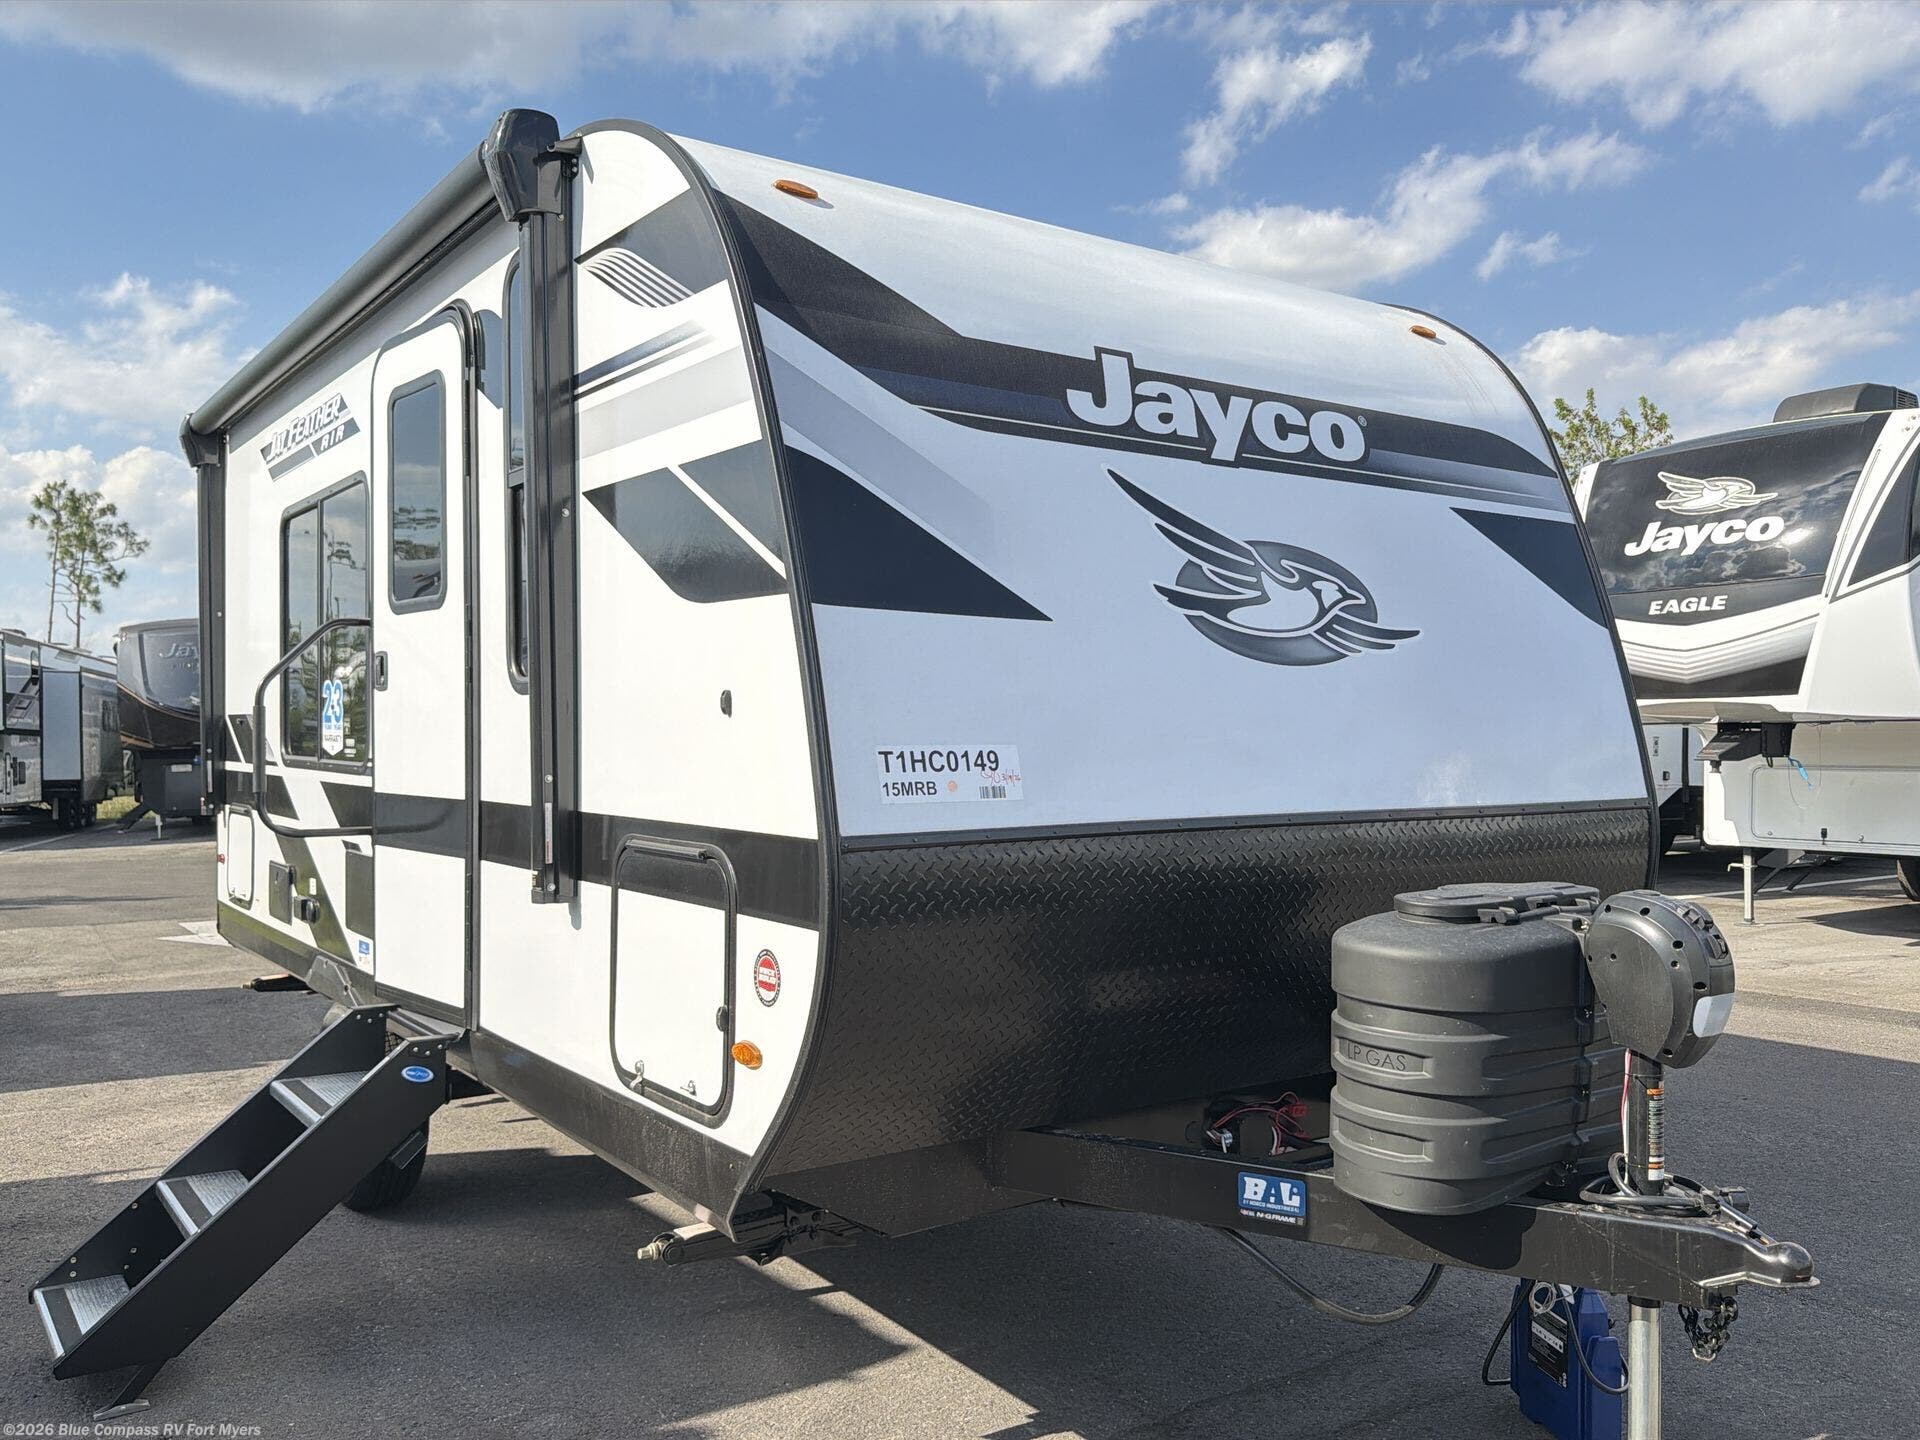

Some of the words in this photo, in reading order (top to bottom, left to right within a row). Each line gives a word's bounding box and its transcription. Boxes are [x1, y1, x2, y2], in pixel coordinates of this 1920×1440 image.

[287, 393, 341, 448] FEATHER
[1066, 353, 1366, 462] Jayco
[321, 425, 345, 451] AIR
[1624, 516, 1785, 557] Jayco
[1648, 595, 1728, 615] EAGLE
[878, 750, 1000, 773] T1HC0149
[882, 781, 938, 797] 15MRB
[1346, 1042, 1362, 1061] LP
[1365, 1048, 1406, 1072] GAS
[1243, 1176, 1301, 1208] BAL
